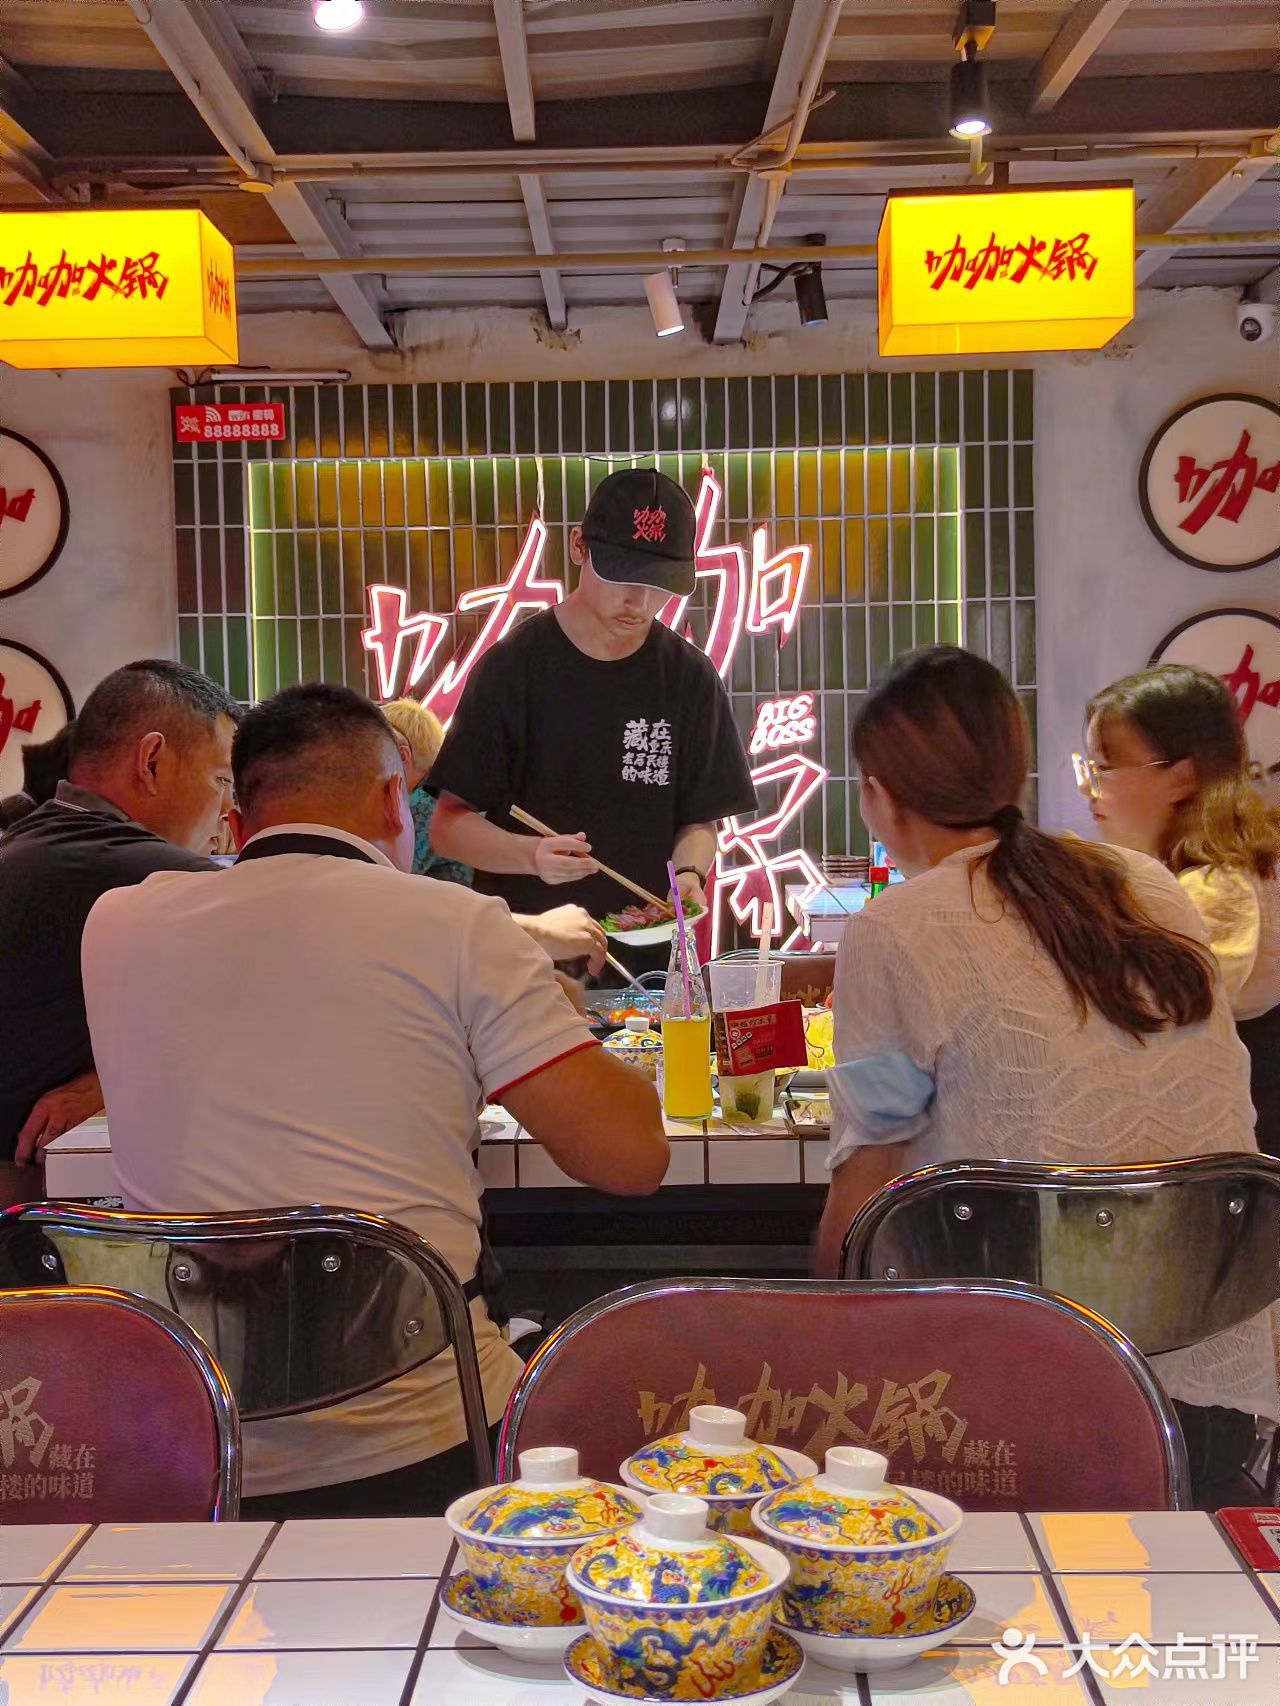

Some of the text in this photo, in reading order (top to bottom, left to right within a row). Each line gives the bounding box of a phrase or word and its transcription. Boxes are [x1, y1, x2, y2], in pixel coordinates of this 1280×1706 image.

[924, 231, 1099, 291] 咖咖火锅
[204, 423, 280, 438] 88888888
[756, 692, 815, 728] BIG
[747, 714, 817, 755] BOSS
[622, 765, 670, 786] 的味道
[49, 1444, 97, 1470] 藏在
[963, 1439, 1017, 1467] 藏在
